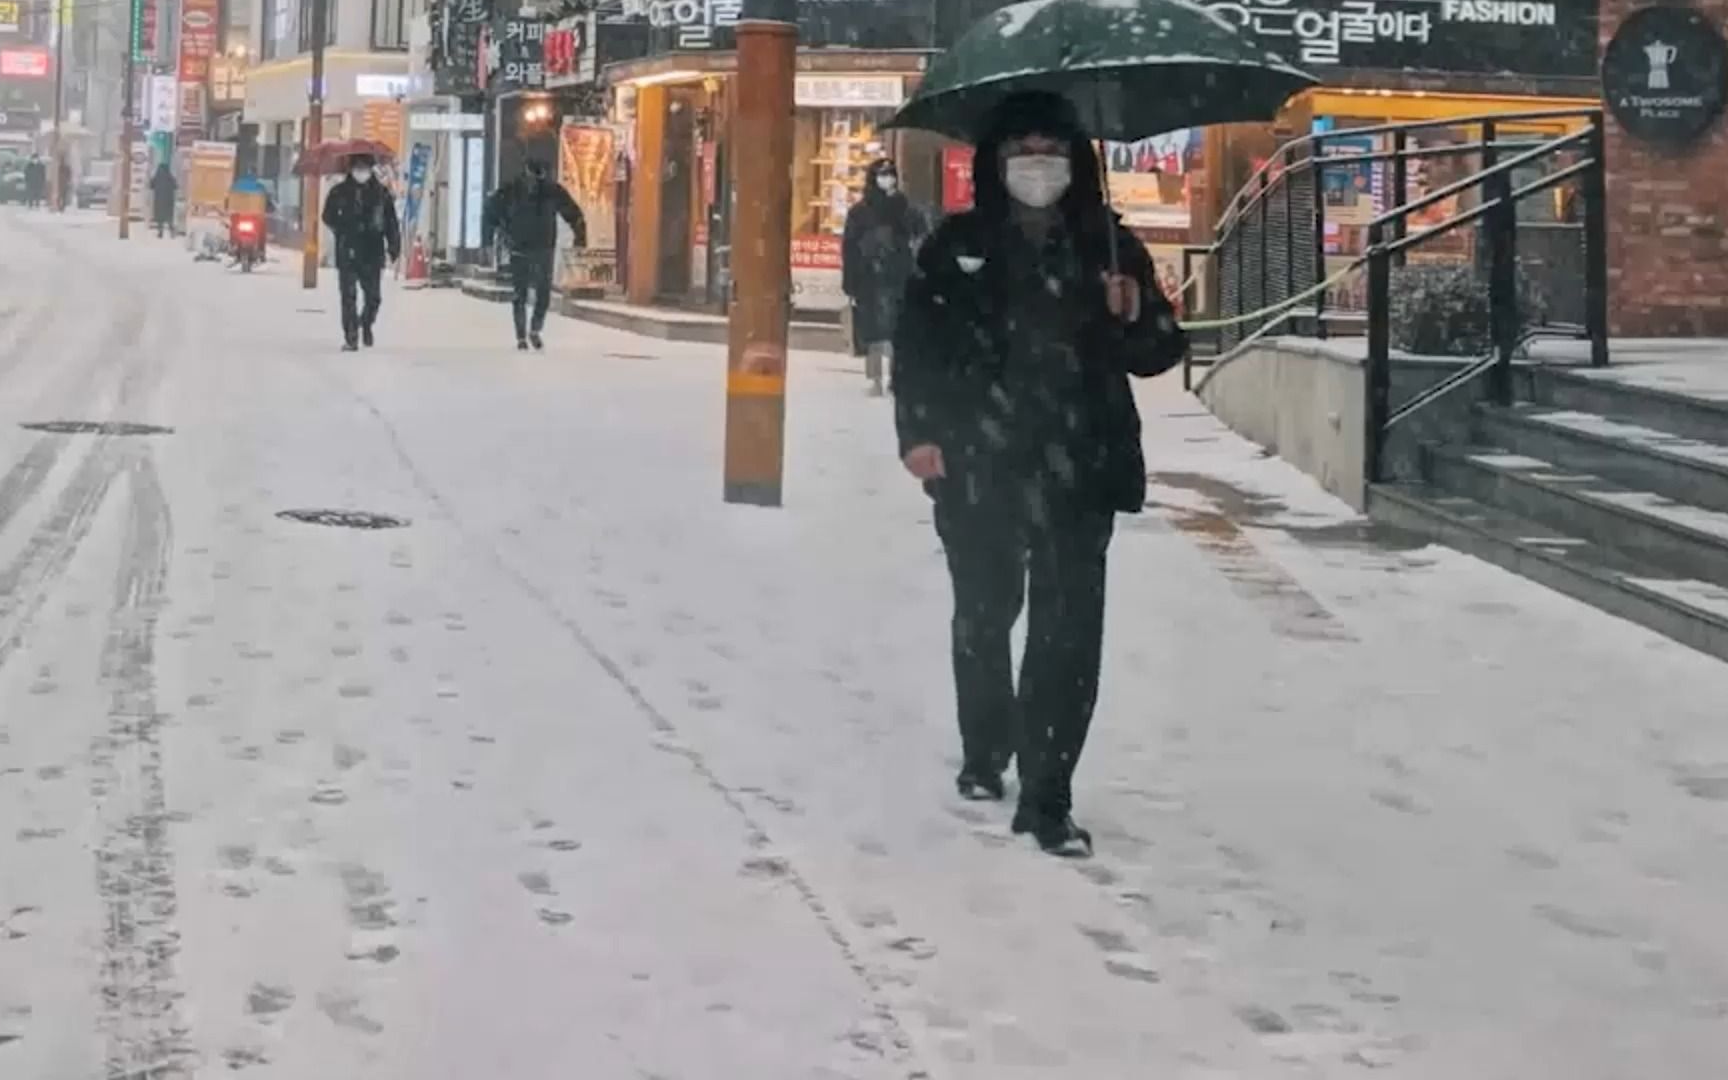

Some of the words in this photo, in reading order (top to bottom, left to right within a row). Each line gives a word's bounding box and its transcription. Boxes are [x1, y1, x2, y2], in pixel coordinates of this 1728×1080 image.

[1442, 0, 1556, 25] FASHION
[1296, 1, 1430, 63] 얼굴이다
[1631, 95, 1702, 107] TWOSOME
[1640, 109, 1679, 118] PLACE
